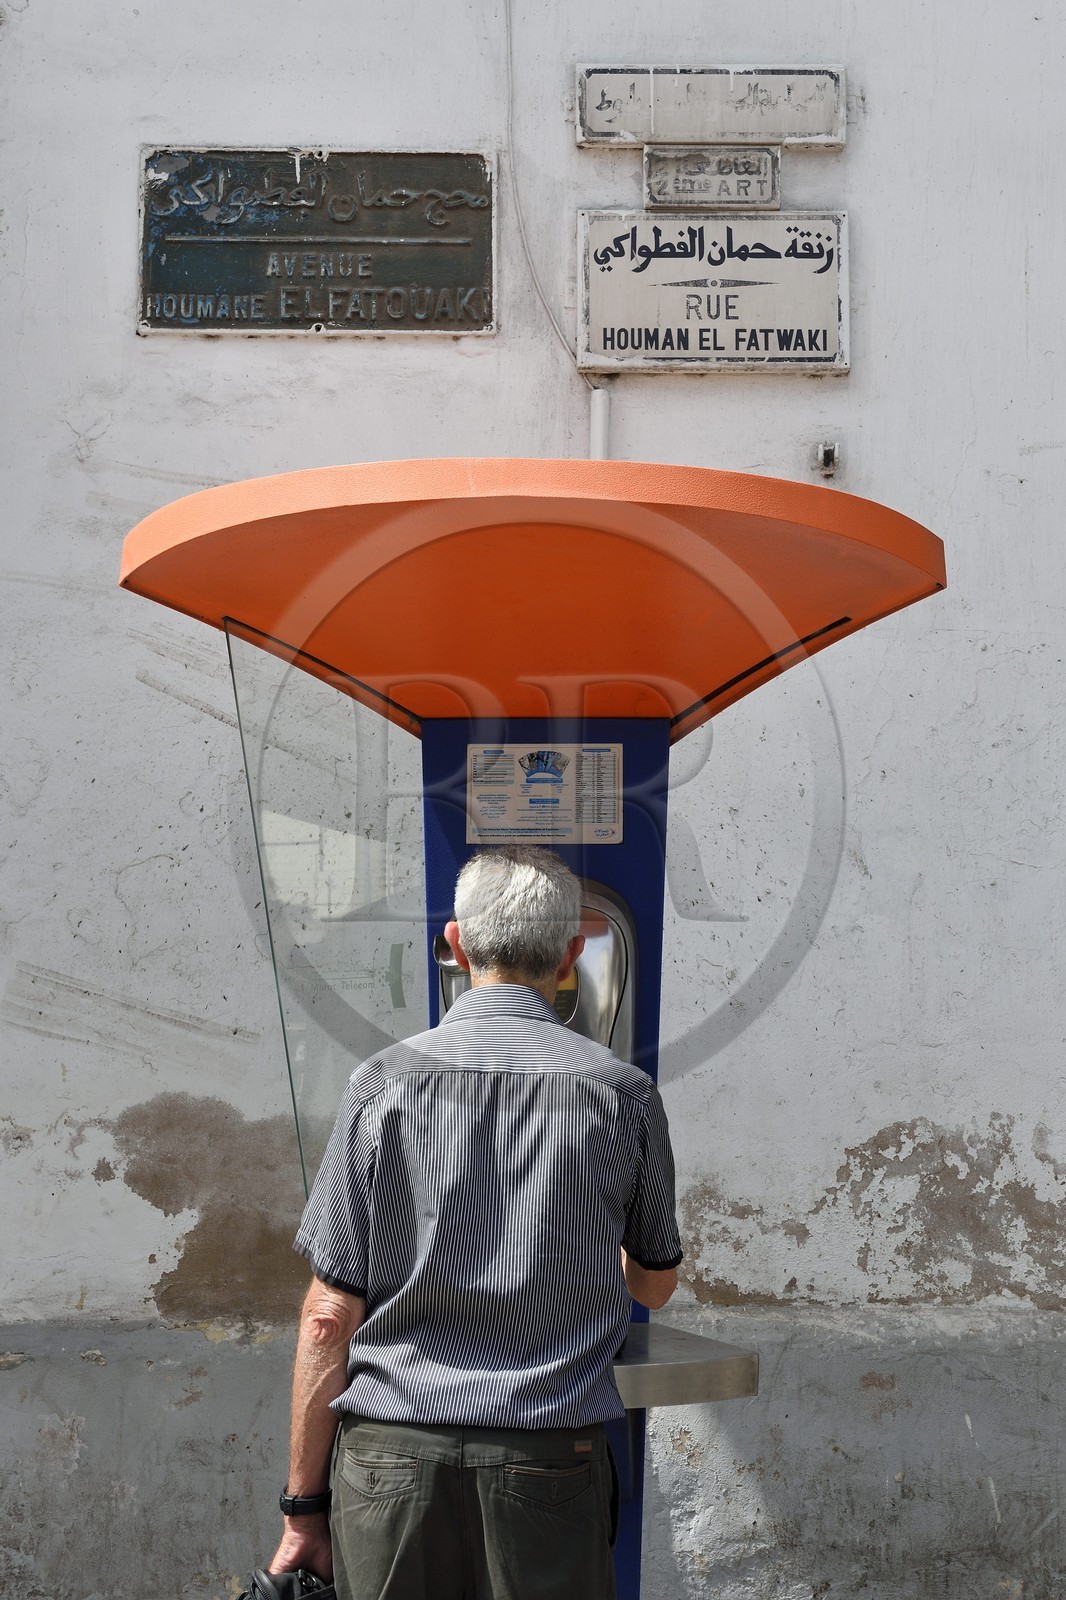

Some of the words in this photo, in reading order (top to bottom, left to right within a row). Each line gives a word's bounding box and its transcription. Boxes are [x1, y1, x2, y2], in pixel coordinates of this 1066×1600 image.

[328, 171, 424, 222] حمان
[717, 179, 767, 196] ART
[593, 226, 705, 273] الفطواكي
[707, 226, 783, 267] حمان
[784, 226, 835, 274] زنقة
[266, 252, 373, 278] AVENUE
[146, 294, 266, 319] HOUMANE
[685, 294, 740, 320] RUE
[602, 327, 689, 351] HOUMAN
[698, 327, 726, 351] EL
[735, 328, 828, 352] FATWAKI
[342, 981, 376, 990] Telecom
